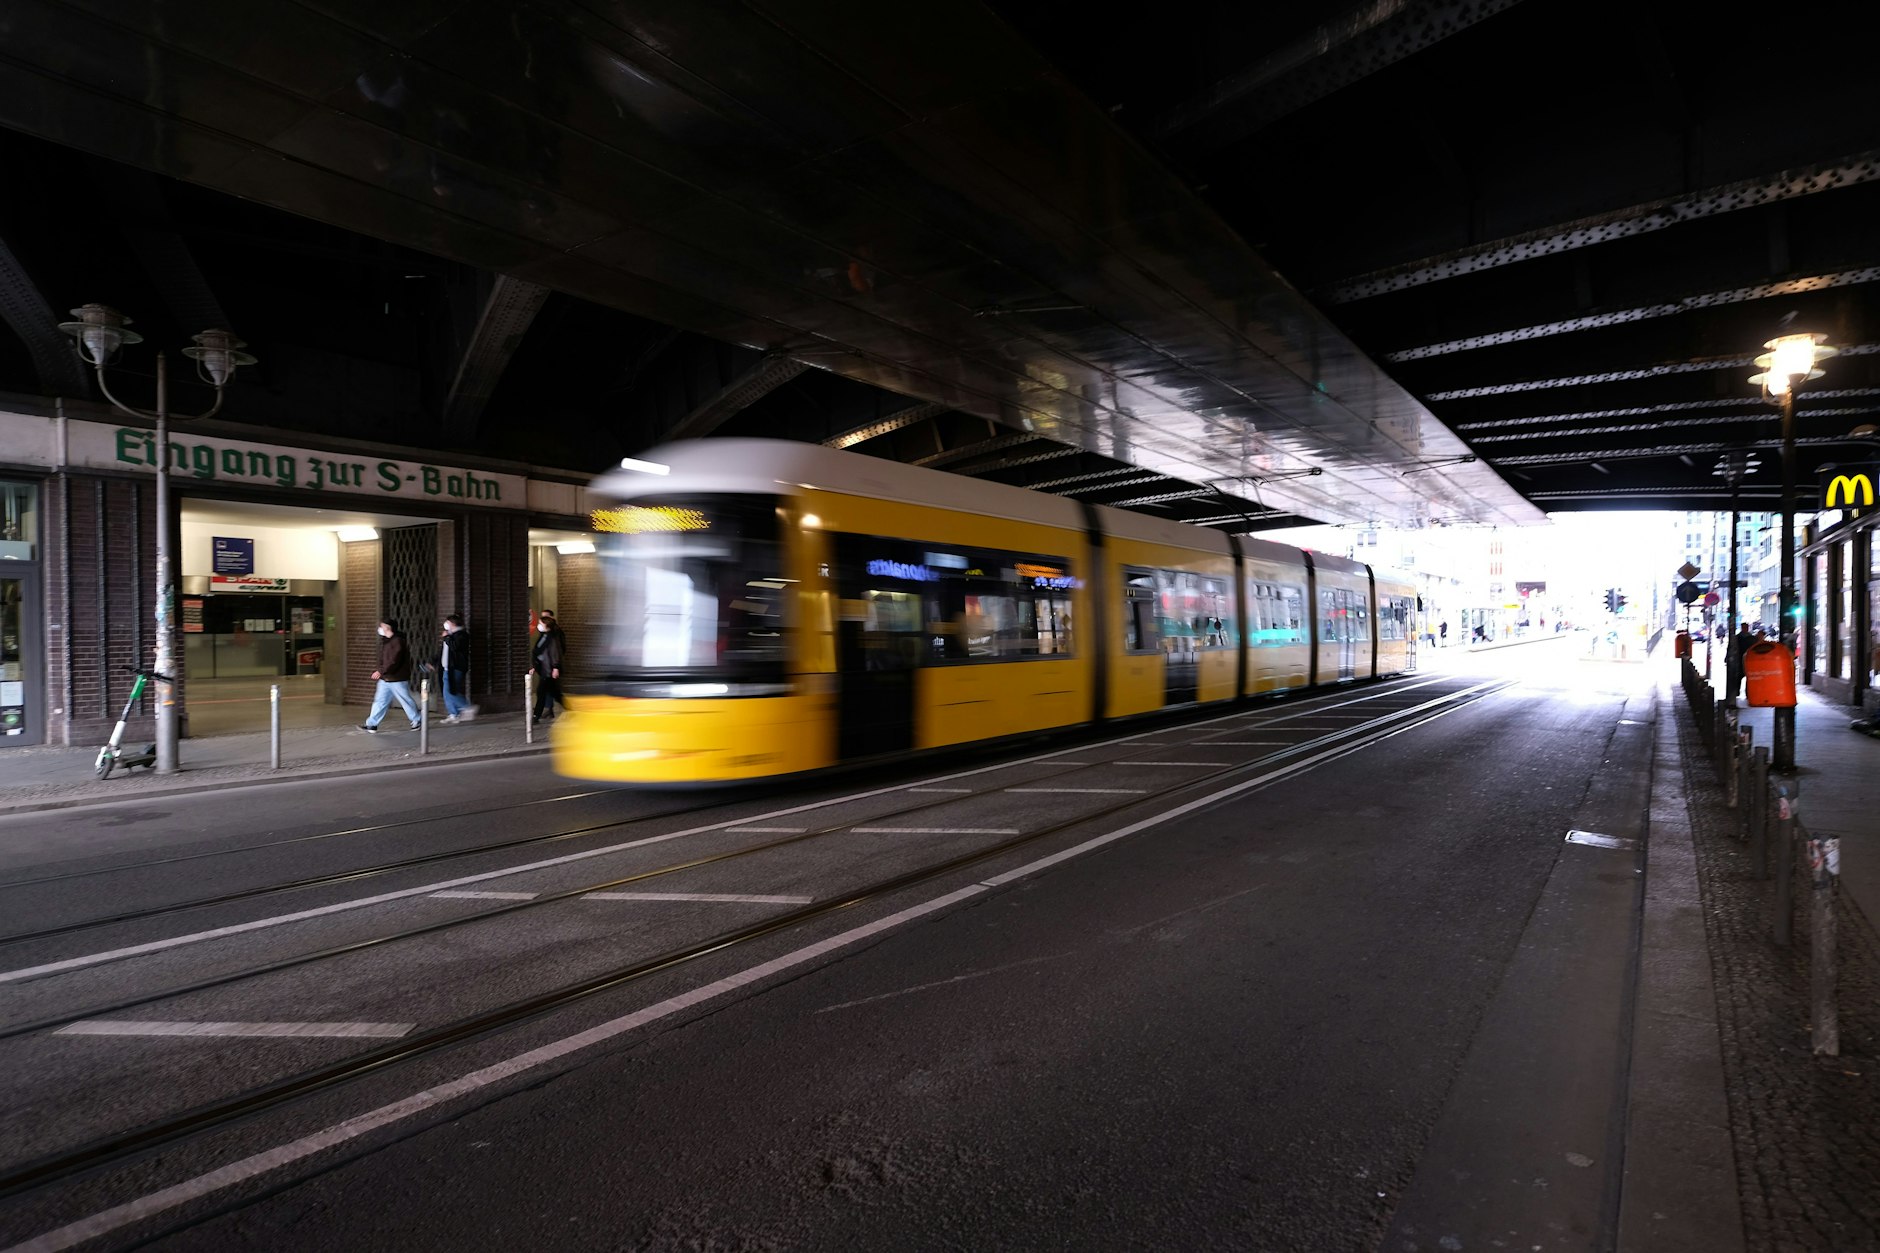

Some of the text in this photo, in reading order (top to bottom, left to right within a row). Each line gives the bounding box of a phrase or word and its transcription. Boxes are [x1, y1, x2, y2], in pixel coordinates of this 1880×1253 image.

[115, 427, 502, 500] Eingang zur S-Bahn
